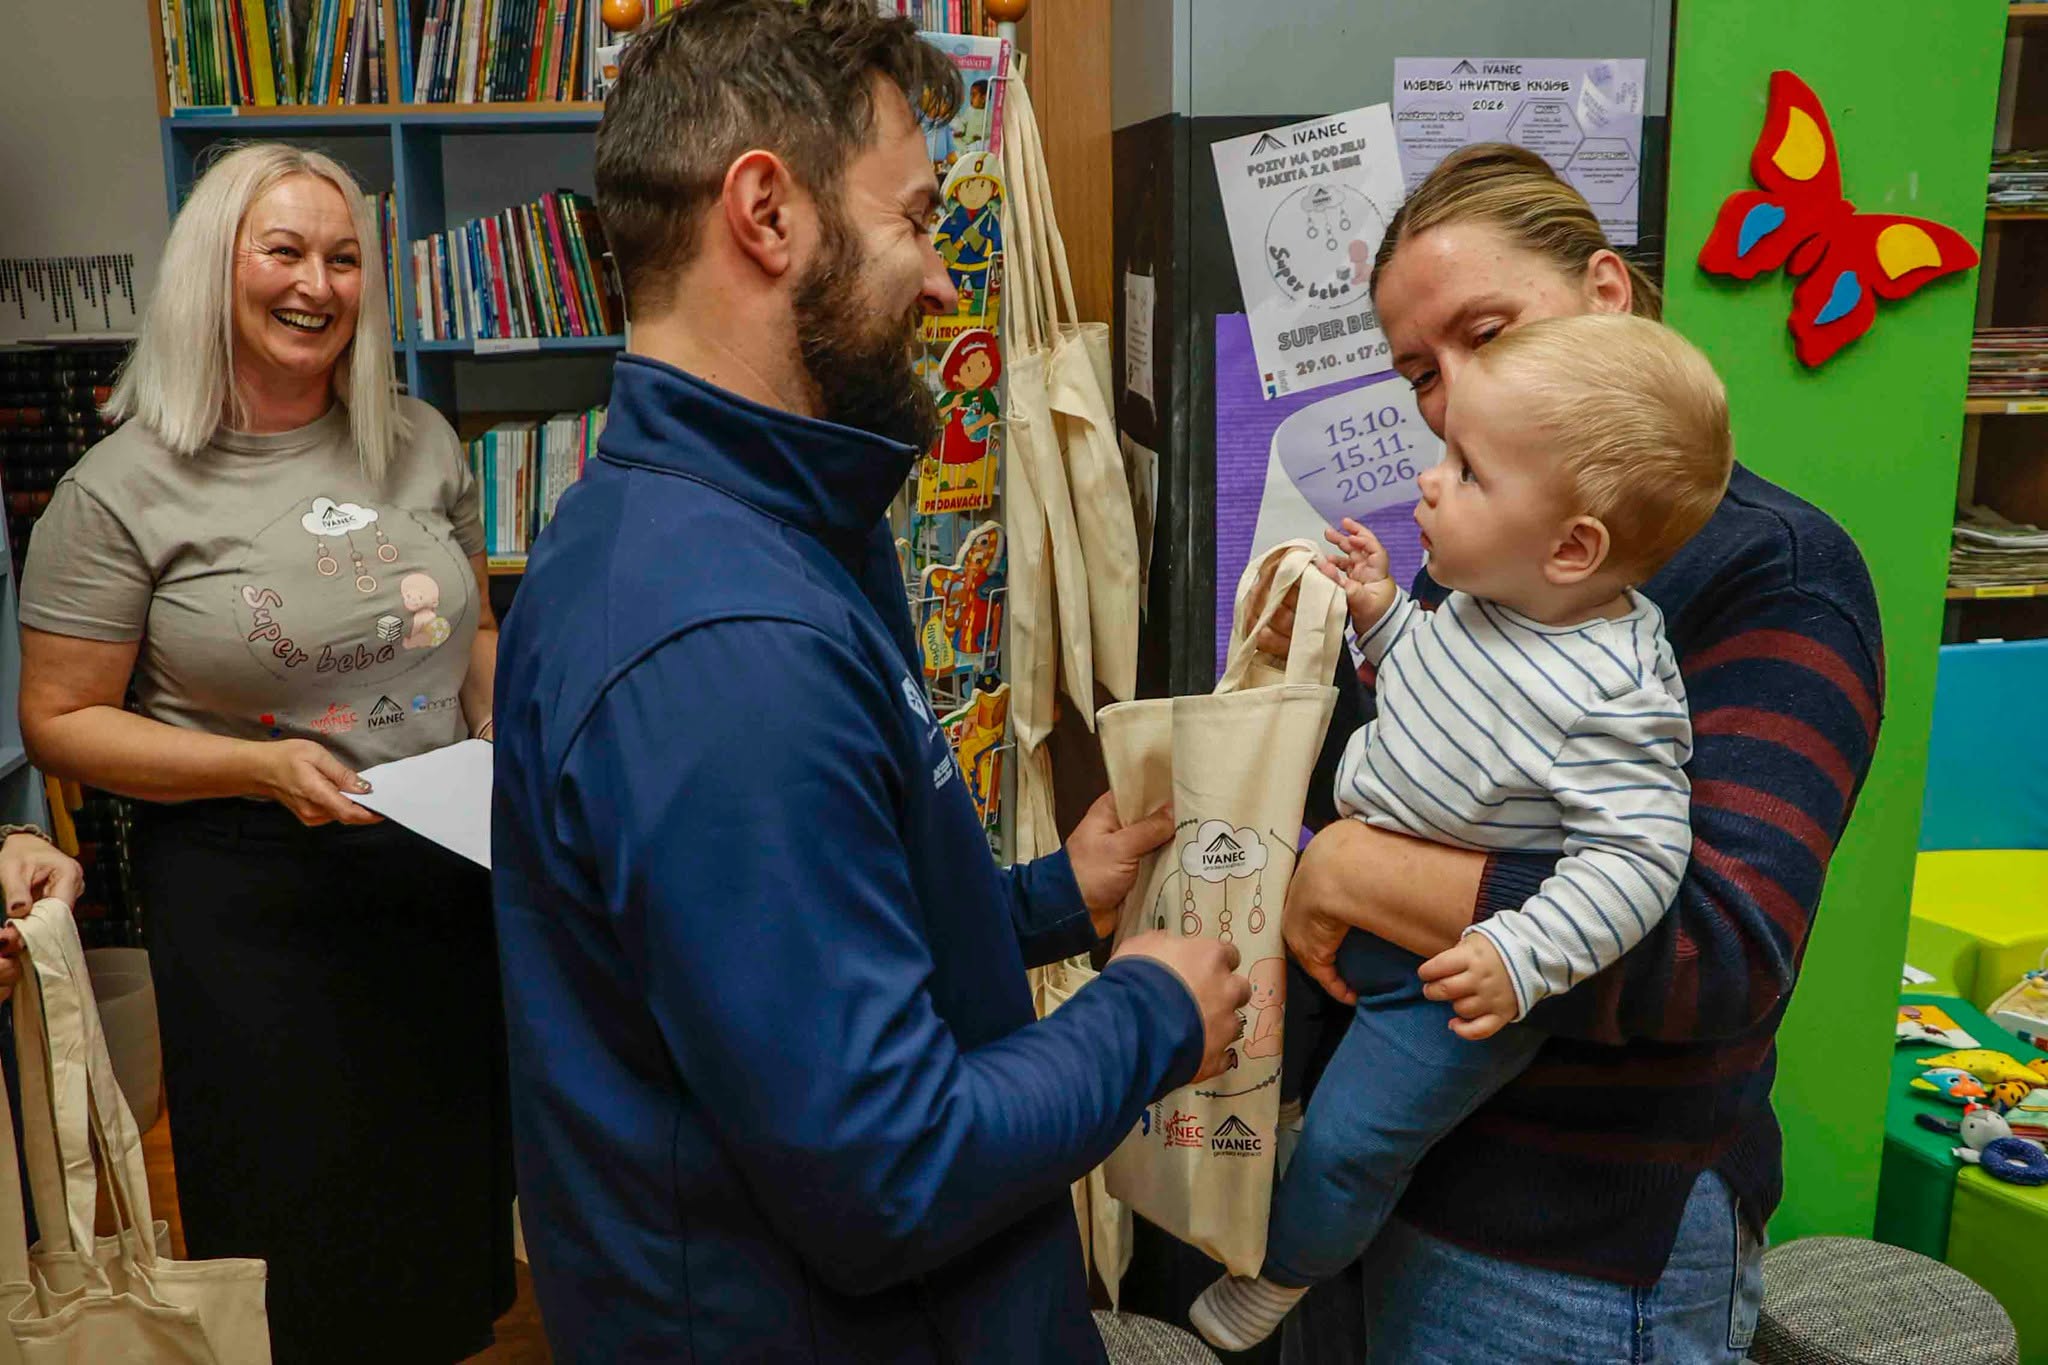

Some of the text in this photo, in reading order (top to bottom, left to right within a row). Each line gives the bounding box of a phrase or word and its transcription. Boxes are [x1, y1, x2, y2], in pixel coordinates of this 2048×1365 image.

[1483, 65, 1522, 75] IVANEC
[1292, 122, 1348, 146] IVANEC
[1247, 157, 1287, 177] POZIV
[1289, 152, 1310, 167] NA
[1311, 164, 1331, 177] ZA
[1308, 282, 1350, 300] beba
[1278, 311, 1379, 352] SUPER BE
[1296, 342, 1389, 377] 29.10. u 17:0
[1325, 406, 1407, 447] 15.10.
[1331, 432, 1414, 474] 15.11.
[1336, 458, 1422, 503] 2026.
[322, 514, 357, 529] IVANEC
[317, 643, 394, 673] beba
[368, 712, 405, 729] IVANEC
[1202, 850, 1246, 865] IVANEC
[1211, 1138, 1262, 1151] IVANEC
